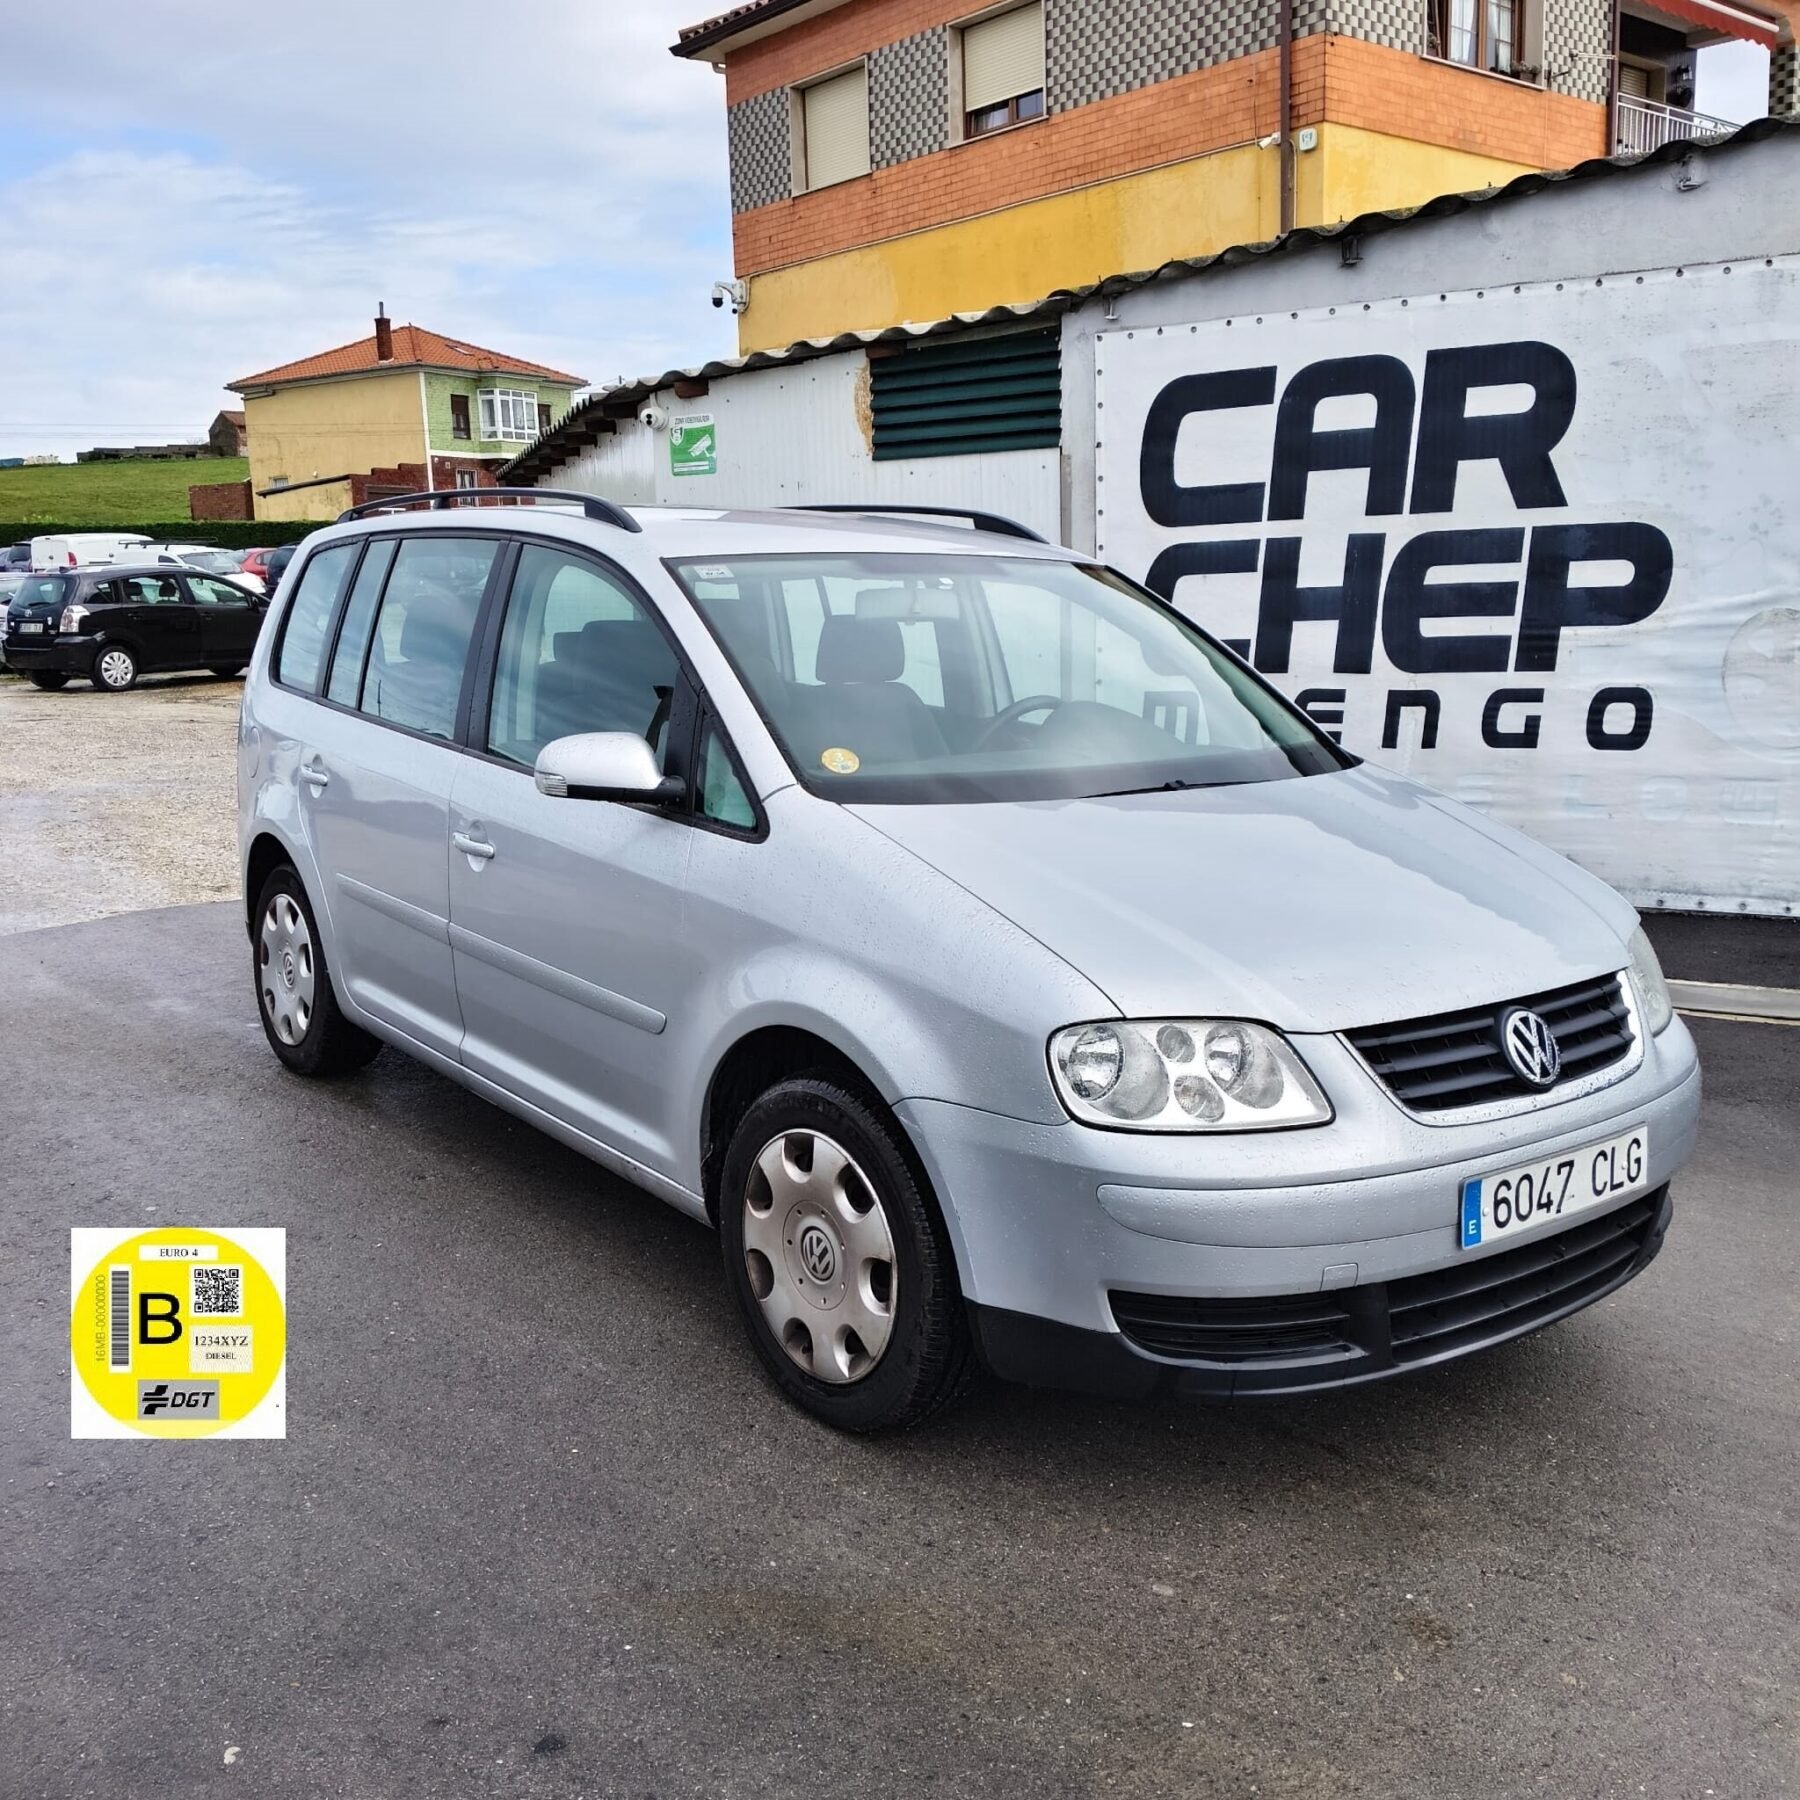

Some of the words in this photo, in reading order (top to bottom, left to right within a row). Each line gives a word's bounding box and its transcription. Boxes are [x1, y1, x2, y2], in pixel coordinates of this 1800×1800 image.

[1140, 340, 1577, 528] CAR
[1140, 522, 1673, 676] CHEP
[1468, 1220, 1476, 1235] E
[1493, 1160, 1574, 1229] 6047
[1592, 1138, 1642, 1197] CLG
